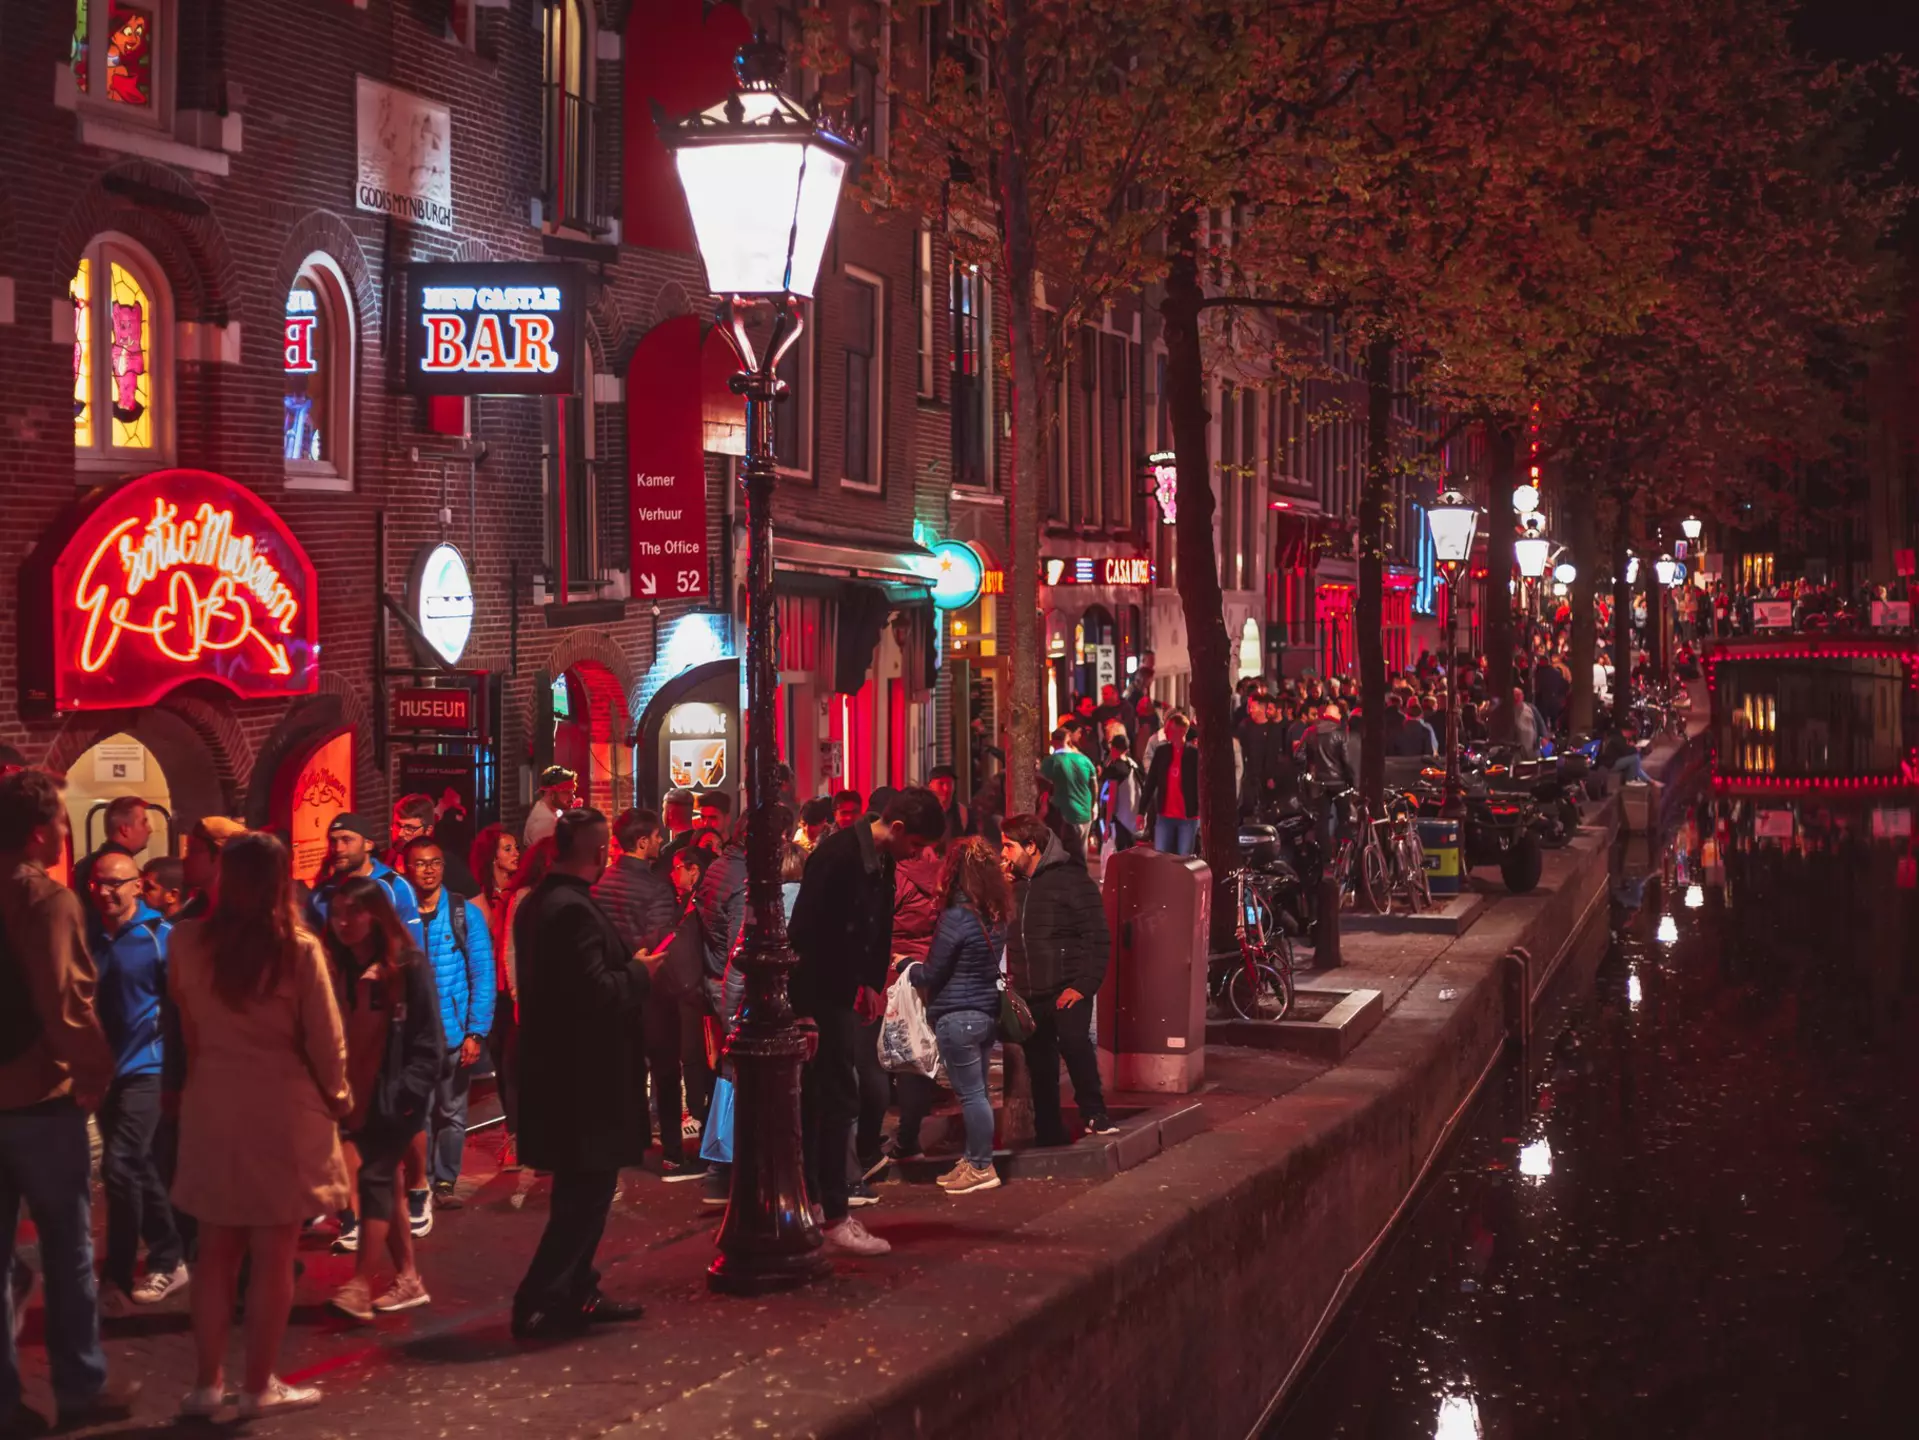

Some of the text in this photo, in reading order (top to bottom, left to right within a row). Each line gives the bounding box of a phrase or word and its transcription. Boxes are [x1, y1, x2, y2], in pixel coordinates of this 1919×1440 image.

[421, 313, 559, 373] BAR
[636, 473, 675, 487] Kamer
[638, 507, 682, 521] Verhuur
[639, 540, 699, 555] The Office
[196, 502, 298, 634] Museum
[1105, 559, 1131, 584] CASA
[676, 570, 700, 592] 52
[400, 700, 465, 717] MUSEUM
